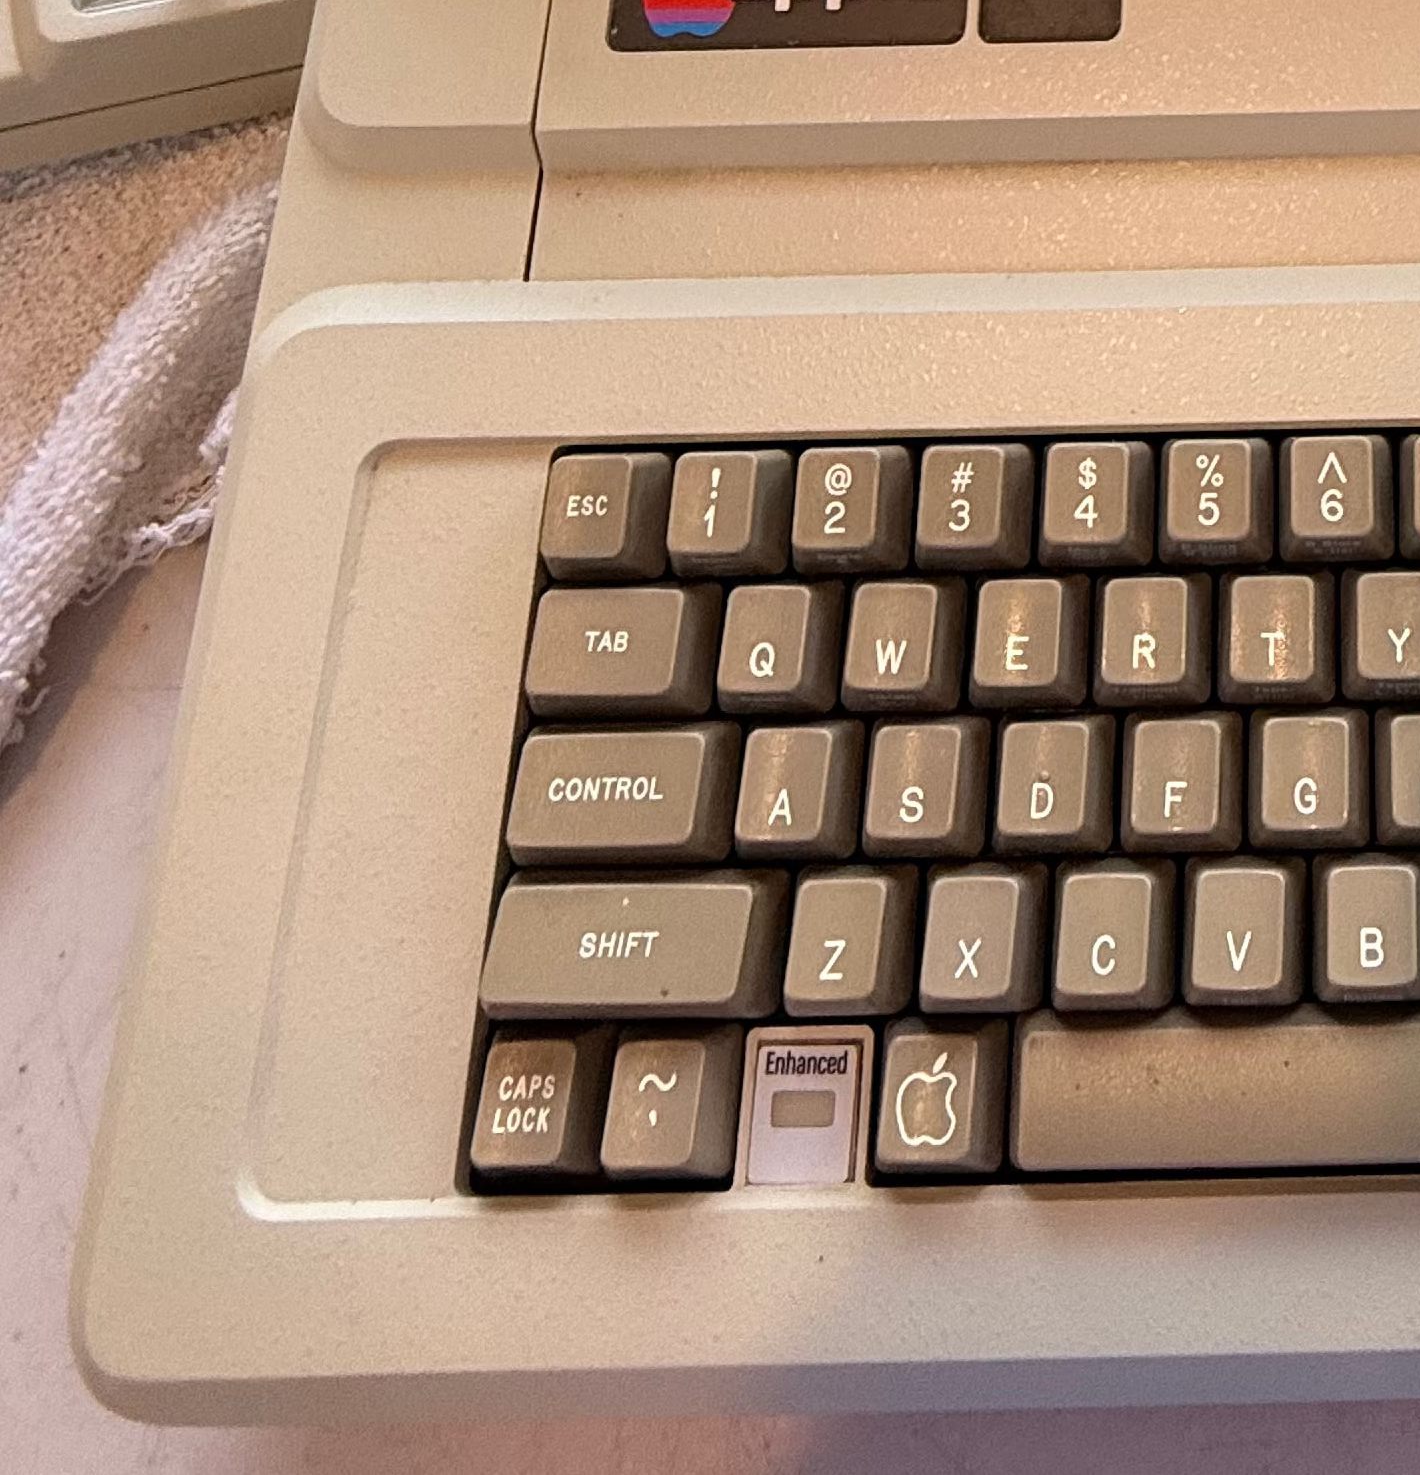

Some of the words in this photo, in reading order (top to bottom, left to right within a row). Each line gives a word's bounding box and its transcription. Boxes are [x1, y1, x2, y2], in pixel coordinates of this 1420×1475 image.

[710, 467, 721, 500] !
[824, 462, 852, 496] @
[950, 461, 975, 494] #
[1078, 456, 1097, 490] $
[1195, 454, 1225, 488] %
[566, 494, 608, 518] ESC
[703, 504, 716, 538] 1
[823, 500, 846, 535] 2
[948, 498, 971, 532] 3
[1073, 494, 1098, 529] 4
[1197, 492, 1220, 526] 5
[1320, 488, 1344, 522] 6
[584, 630, 629, 653] TAB
[875, 638, 907, 675] W
[1005, 635, 1030, 671] E
[1132, 632, 1156, 670] R
[1260, 631, 1287, 667] T
[1387, 627, 1411, 663] Y
[748, 641, 775, 678] Q
[548, 776, 664, 802] CONTROL
[899, 786, 924, 823] S
[1030, 781, 1054, 820] D
[1163, 780, 1188, 818] F
[1293, 776, 1318, 815] G
[766, 788, 792, 826] A
[578, 930, 660, 959] SHIFT
[818, 939, 846, 981] Z
[954, 937, 982, 979] X
[1091, 934, 1116, 976] C
[1226, 930, 1252, 972] V
[1359, 927, 1385, 968] B
[765, 1049, 848, 1075] Enhanced
[497, 1074, 556, 1102] CAPS
[490, 1106, 551, 1135] LOCK
